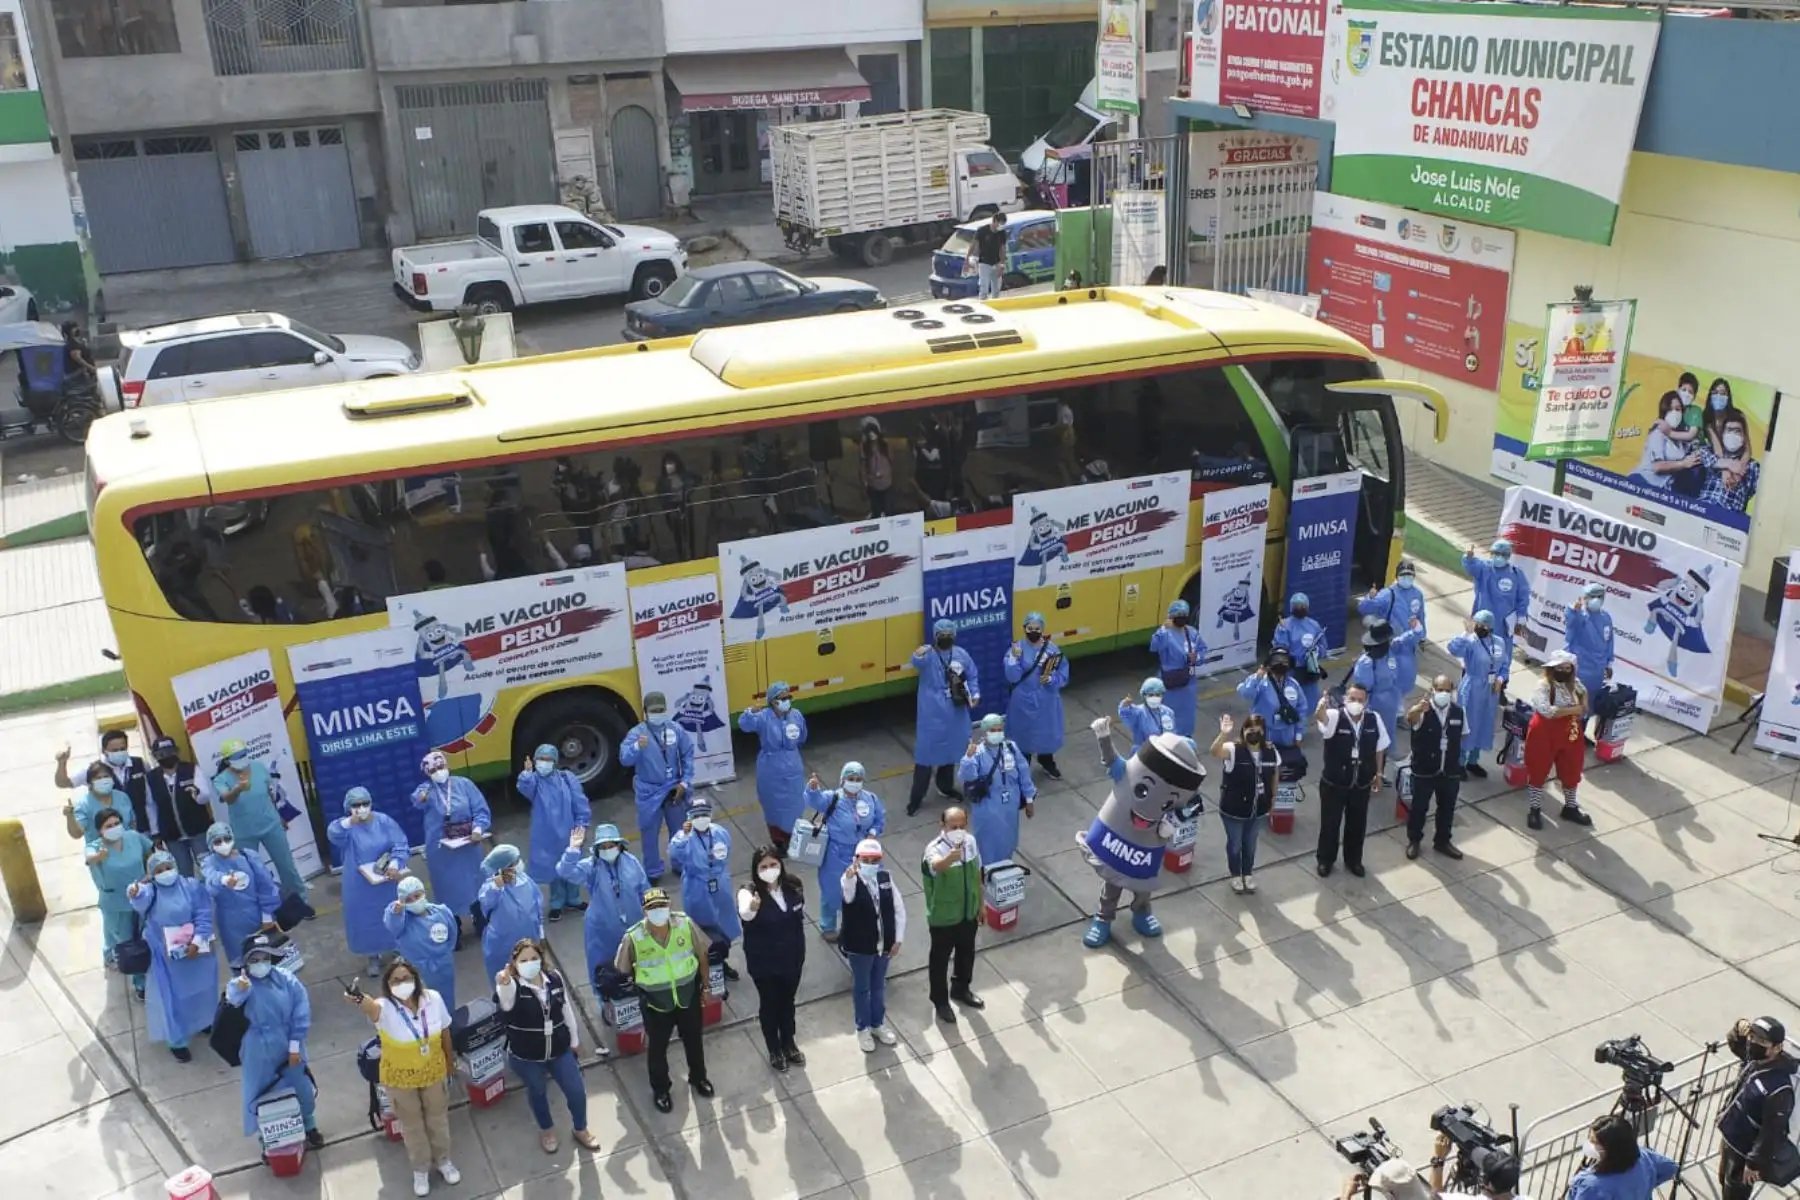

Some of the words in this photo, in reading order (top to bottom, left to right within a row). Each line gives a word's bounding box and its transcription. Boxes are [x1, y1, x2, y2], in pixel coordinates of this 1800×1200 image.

[1224, 4, 1325, 37] PEATONAL
[1380, 31, 1479, 74] ESTADIO
[1485, 38, 1635, 86] MUNICIPAL
[731, 94, 768, 105] BODEGA
[1411, 77, 1542, 130] CHANCAS
[1233, 148, 1286, 162] GRACIAS
[1413, 124, 1430, 144] DE
[1433, 127, 1529, 156] ANDAHUAYLAS
[1410, 165, 1447, 188] Jose
[1450, 170, 1481, 192] Luis
[1485, 178, 1521, 201] Nole
[1433, 192, 1491, 214] ALCALDE
[1544, 401, 1576, 413] Santa
[1579, 398, 1609, 411] Anita
[1066, 513, 1090, 532] ME
[1094, 495, 1160, 522] VACUNO
[1205, 512, 1221, 524] ME
[1223, 499, 1268, 519] VACUNO
[1519, 499, 1553, 525] ME
[1558, 507, 1657, 552] VACUNO
[1090, 515, 1138, 546] PERÚ
[1298, 518, 1348, 541] MINSA
[782, 561, 810, 581] ME
[813, 540, 889, 571] VACUNO
[1547, 537, 1621, 577] PERÚ
[812, 562, 866, 595] PERÚ
[1606, 585, 1631, 599] DOSIS
[464, 615, 495, 637] ME
[500, 591, 587, 626] VACUNO
[635, 608, 655, 622] ME
[658, 591, 716, 615] VACUNO
[931, 586, 1007, 618] MINSA
[1545, 600, 1566, 613] cent
[500, 615, 561, 651] PERÚ
[658, 607, 699, 632] PERÚ
[960, 617, 982, 628] LIMA
[983, 611, 1006, 622] ESTE
[183, 697, 206, 717] ME
[207, 669, 270, 703] VACUNO
[210, 690, 255, 723] PERÚ
[311, 696, 416, 737] MINSA
[322, 738, 353, 753] DIRIS
[355, 731, 384, 747] LIMA
[386, 724, 417, 740] ESTE
[1102, 831, 1153, 867] MINSA
[617, 1003, 640, 1017] MIN
[264, 1118, 303, 1135] MINSA
